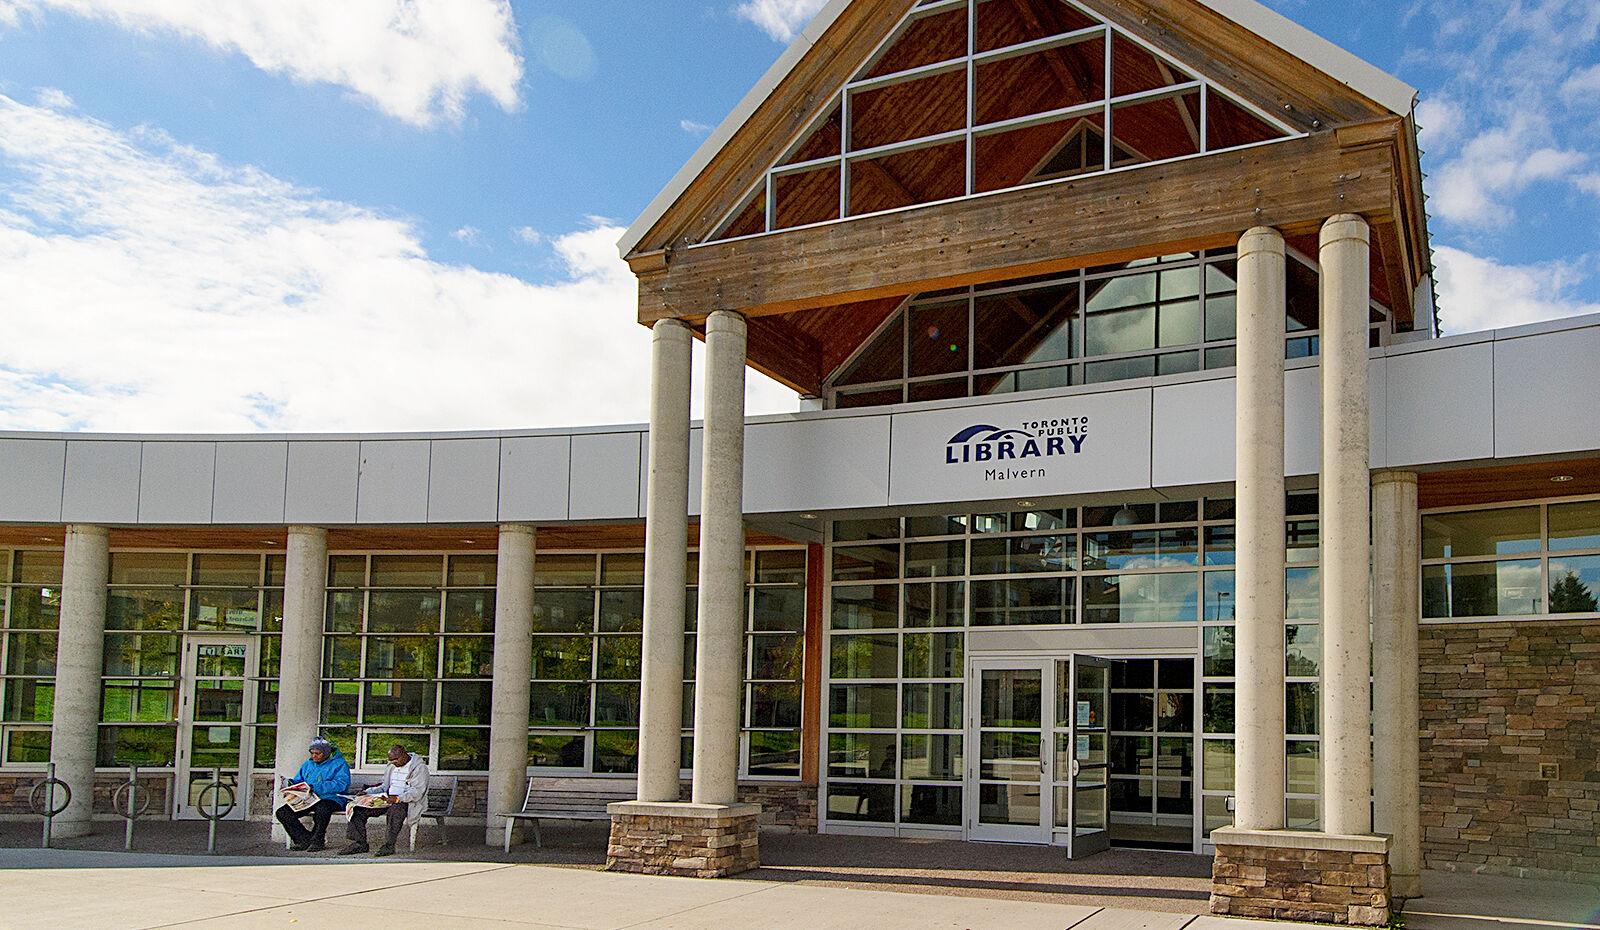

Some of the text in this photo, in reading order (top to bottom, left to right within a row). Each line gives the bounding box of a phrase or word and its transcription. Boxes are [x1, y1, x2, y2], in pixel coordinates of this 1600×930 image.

[1022, 416, 1089, 430] TORONTO
[1038, 425, 1088, 437] PUBLIC
[946, 434, 1087, 464] LIBRARY
[985, 468, 1046, 481] Malvern
